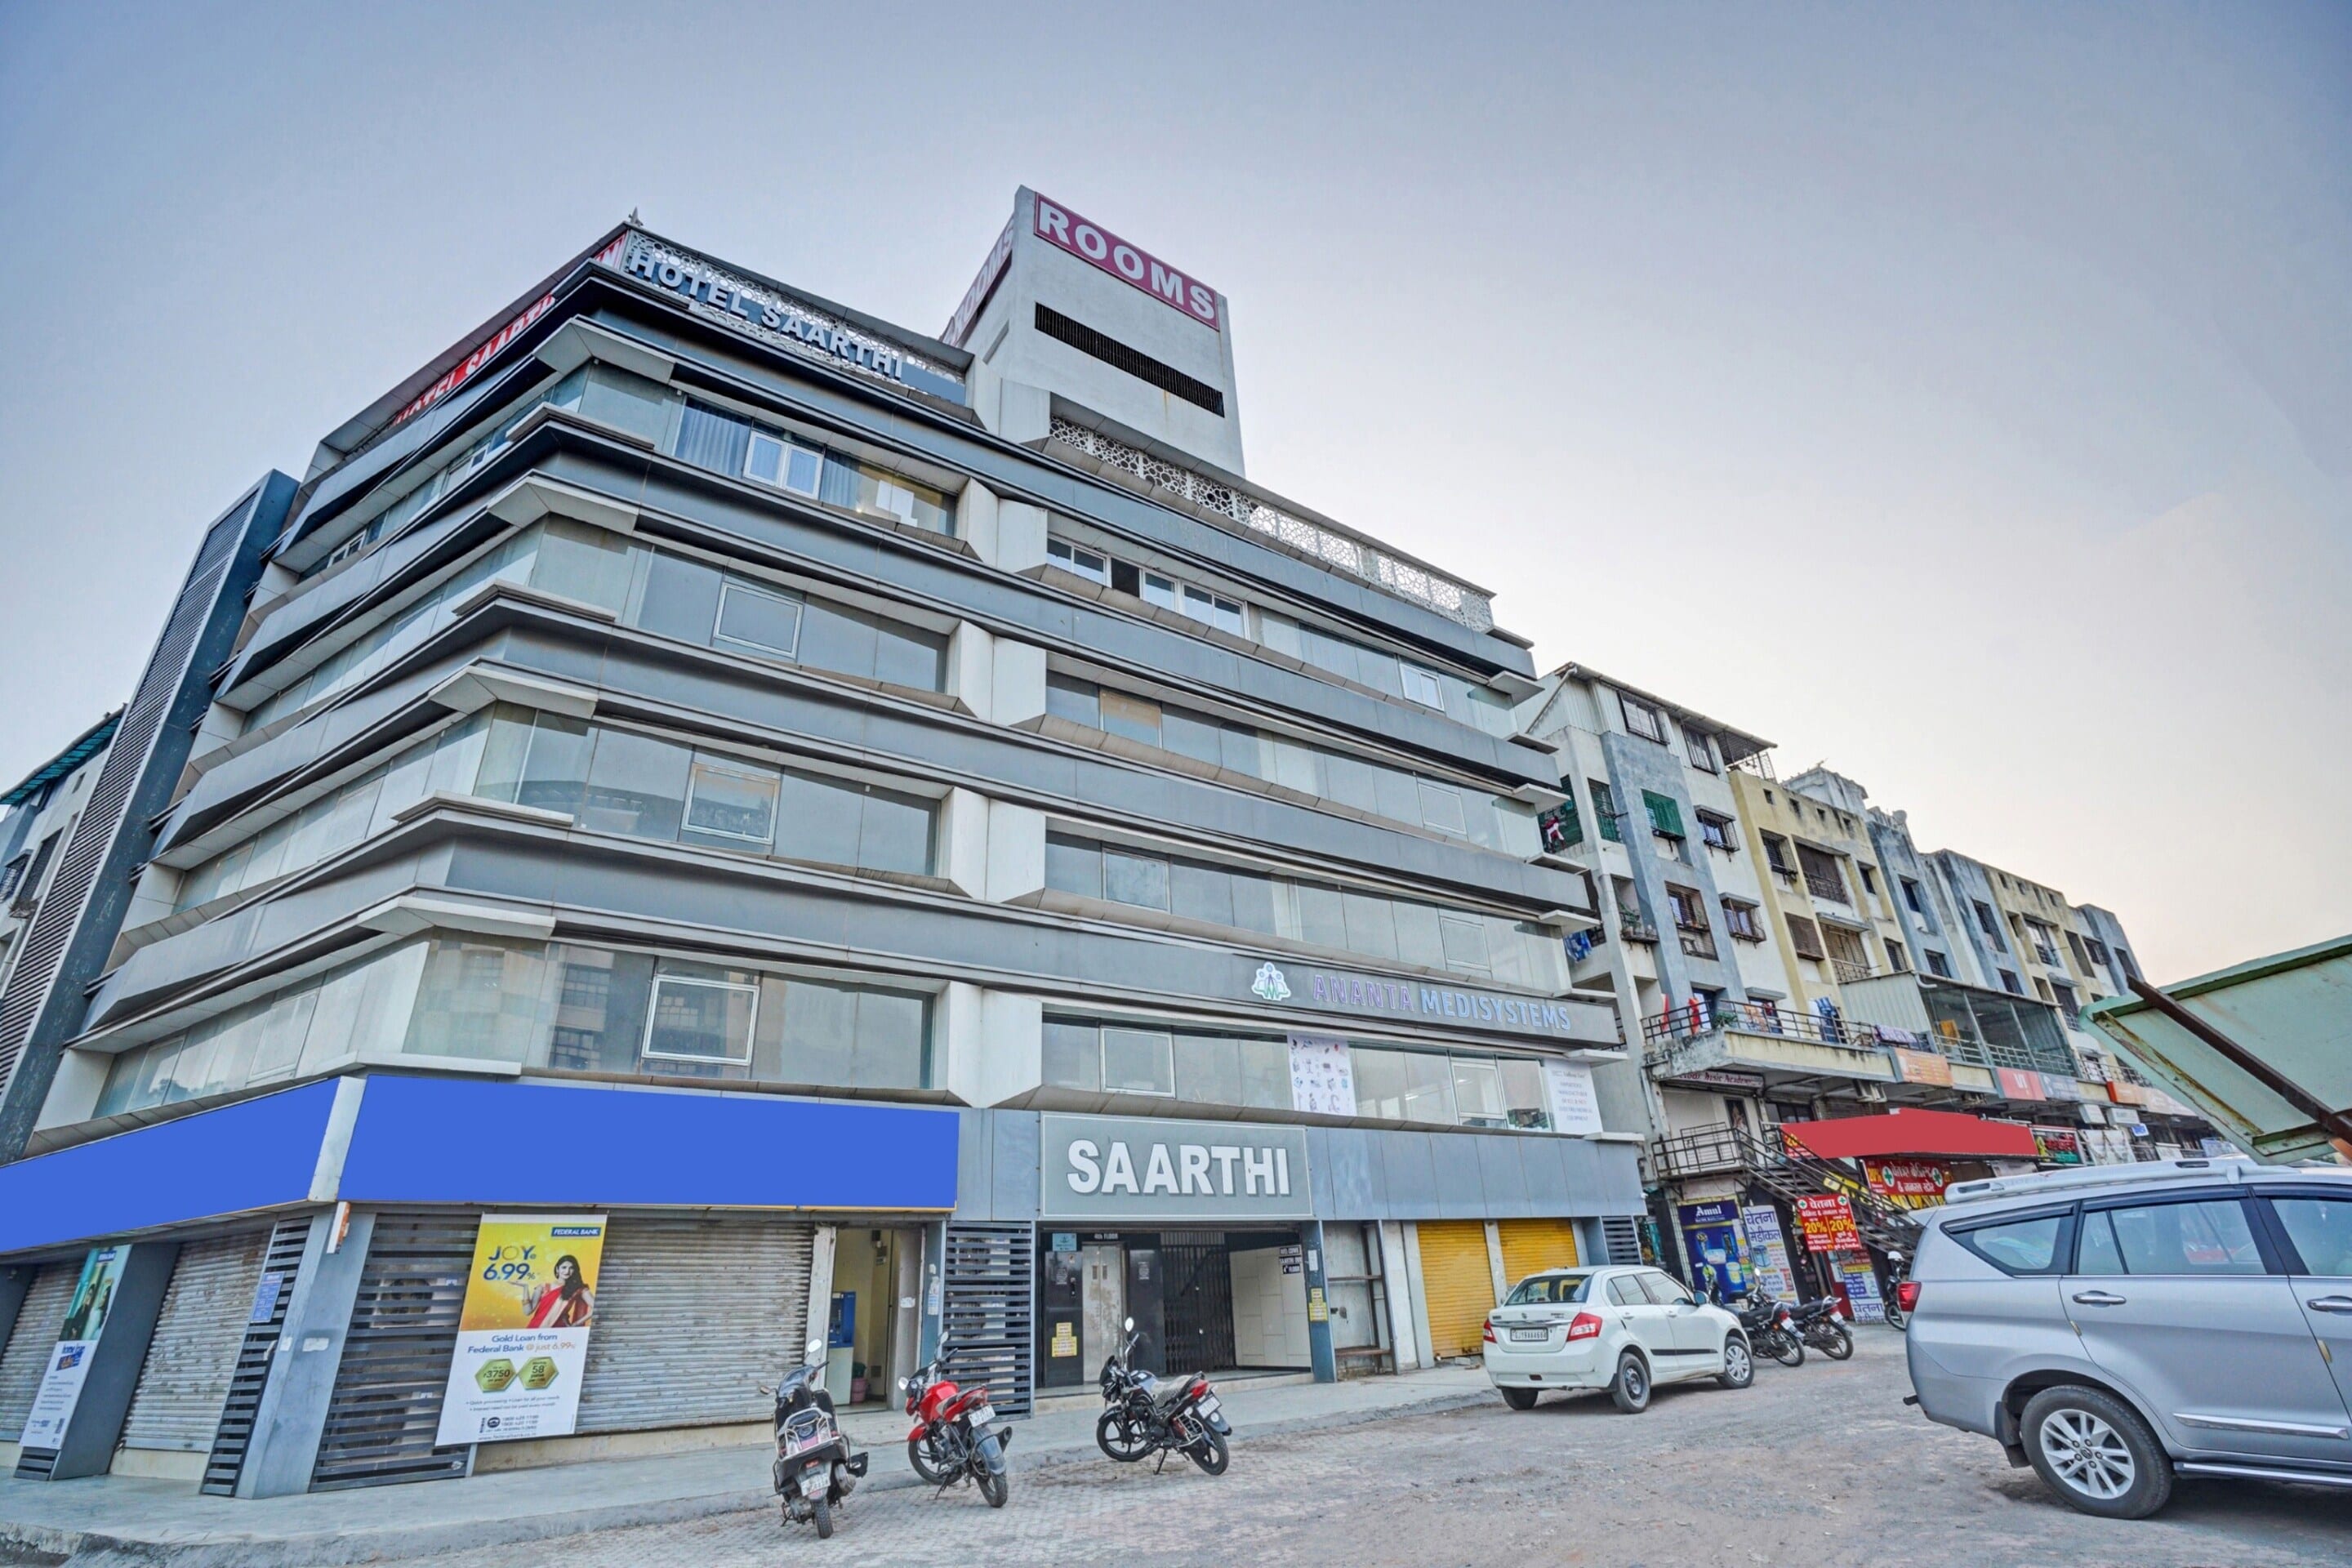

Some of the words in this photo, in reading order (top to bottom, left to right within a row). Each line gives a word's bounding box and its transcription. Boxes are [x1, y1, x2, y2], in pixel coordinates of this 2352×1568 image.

[1039, 201, 1214, 319] ROOMS
[629, 247, 748, 317] HOTEL
[760, 304, 903, 381] SAARTHI
[1312, 974, 1415, 1012] ANANTA
[1419, 988, 1571, 1031] MEDISYSTEMS
[1067, 1138, 1290, 1196] SAARTHI
[1695, 1205, 1722, 1217] Amul
[1745, 1209, 1777, 1225] चेतना
[1805, 1222, 1828, 1233] 20%
[1829, 1219, 1855, 1232] 20%
[492, 1334, 514, 1343] Gold
[515, 1334, 537, 1342] Loan
[537, 1333, 558, 1341] from
[468, 1345, 501, 1354] Federal
[502, 1344, 524, 1352] Bank
[536, 1343, 550, 1352] just
[532, 1365, 545, 1374] 58
